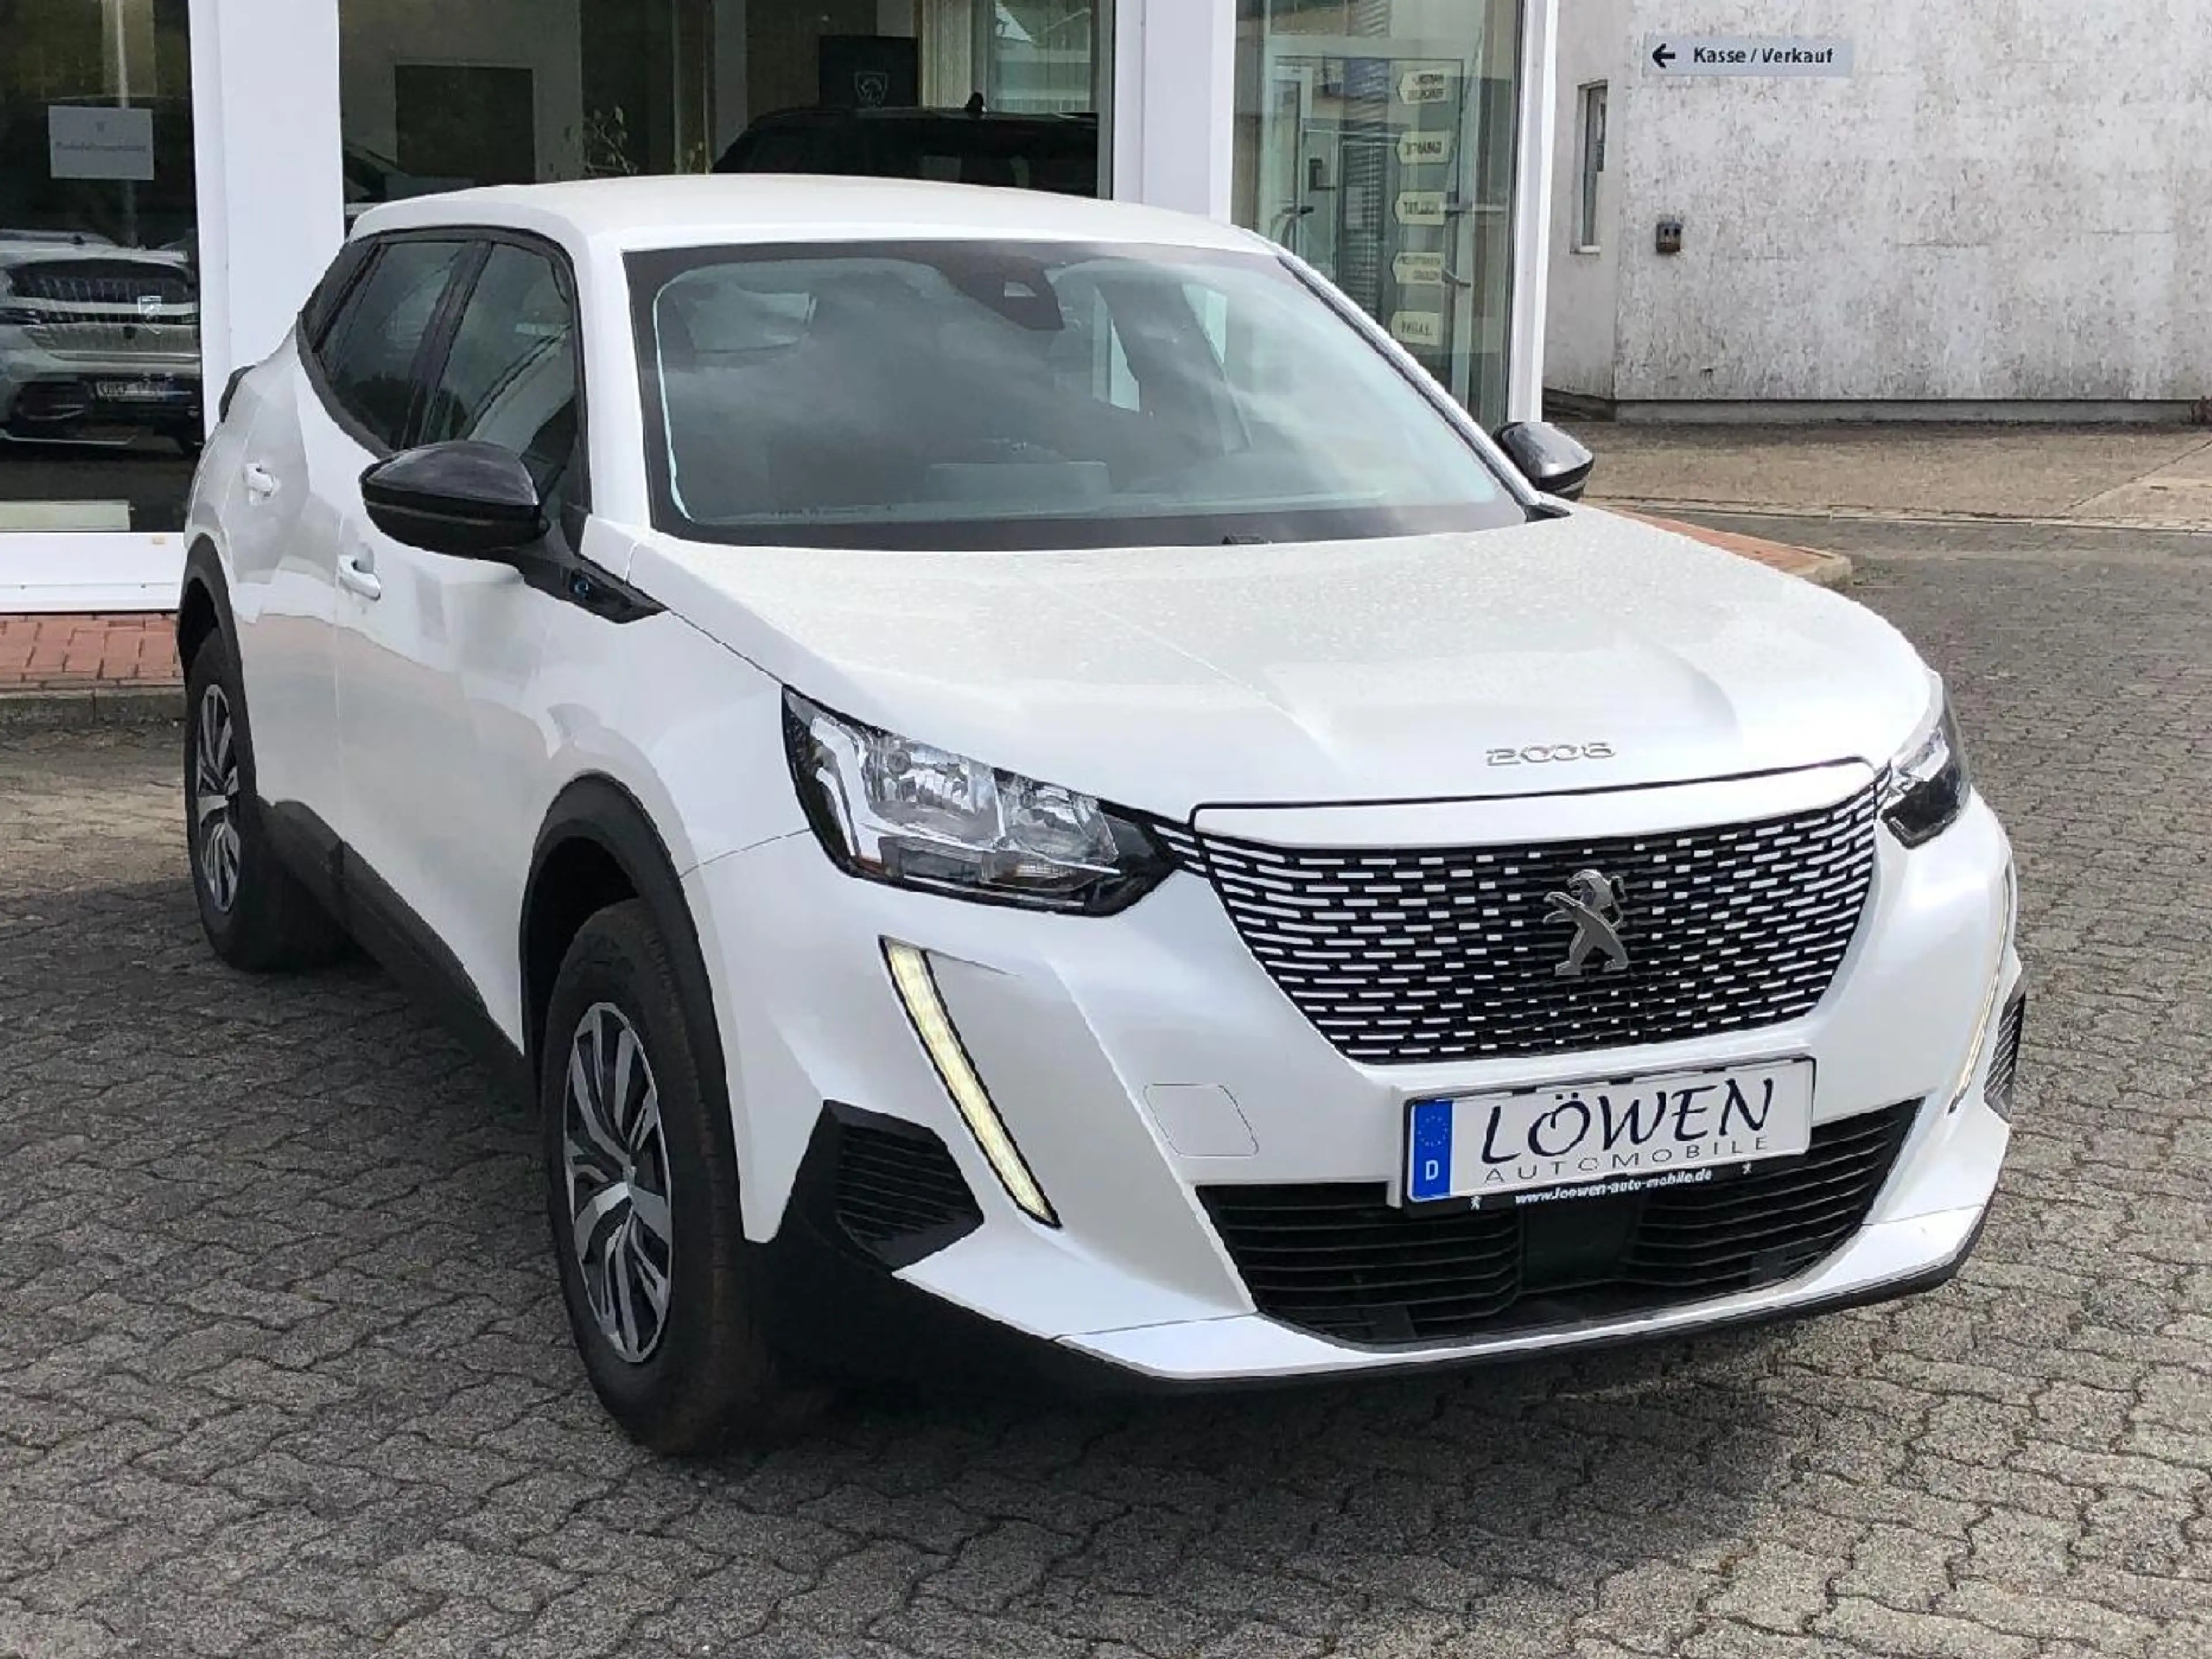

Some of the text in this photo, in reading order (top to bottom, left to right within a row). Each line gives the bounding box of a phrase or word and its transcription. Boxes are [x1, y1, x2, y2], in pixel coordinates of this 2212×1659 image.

[1693, 47, 1746, 63] Kasse
[1762, 47, 1834, 63] Verkauf
[1480, 1077, 1774, 1165] LÖWEN
[1425, 1159, 1439, 1181] D
[1483, 1136, 1769, 1184] AUTOMOBILE
[1514, 1167, 1713, 1206] www.loewen-auto-mobile.de
